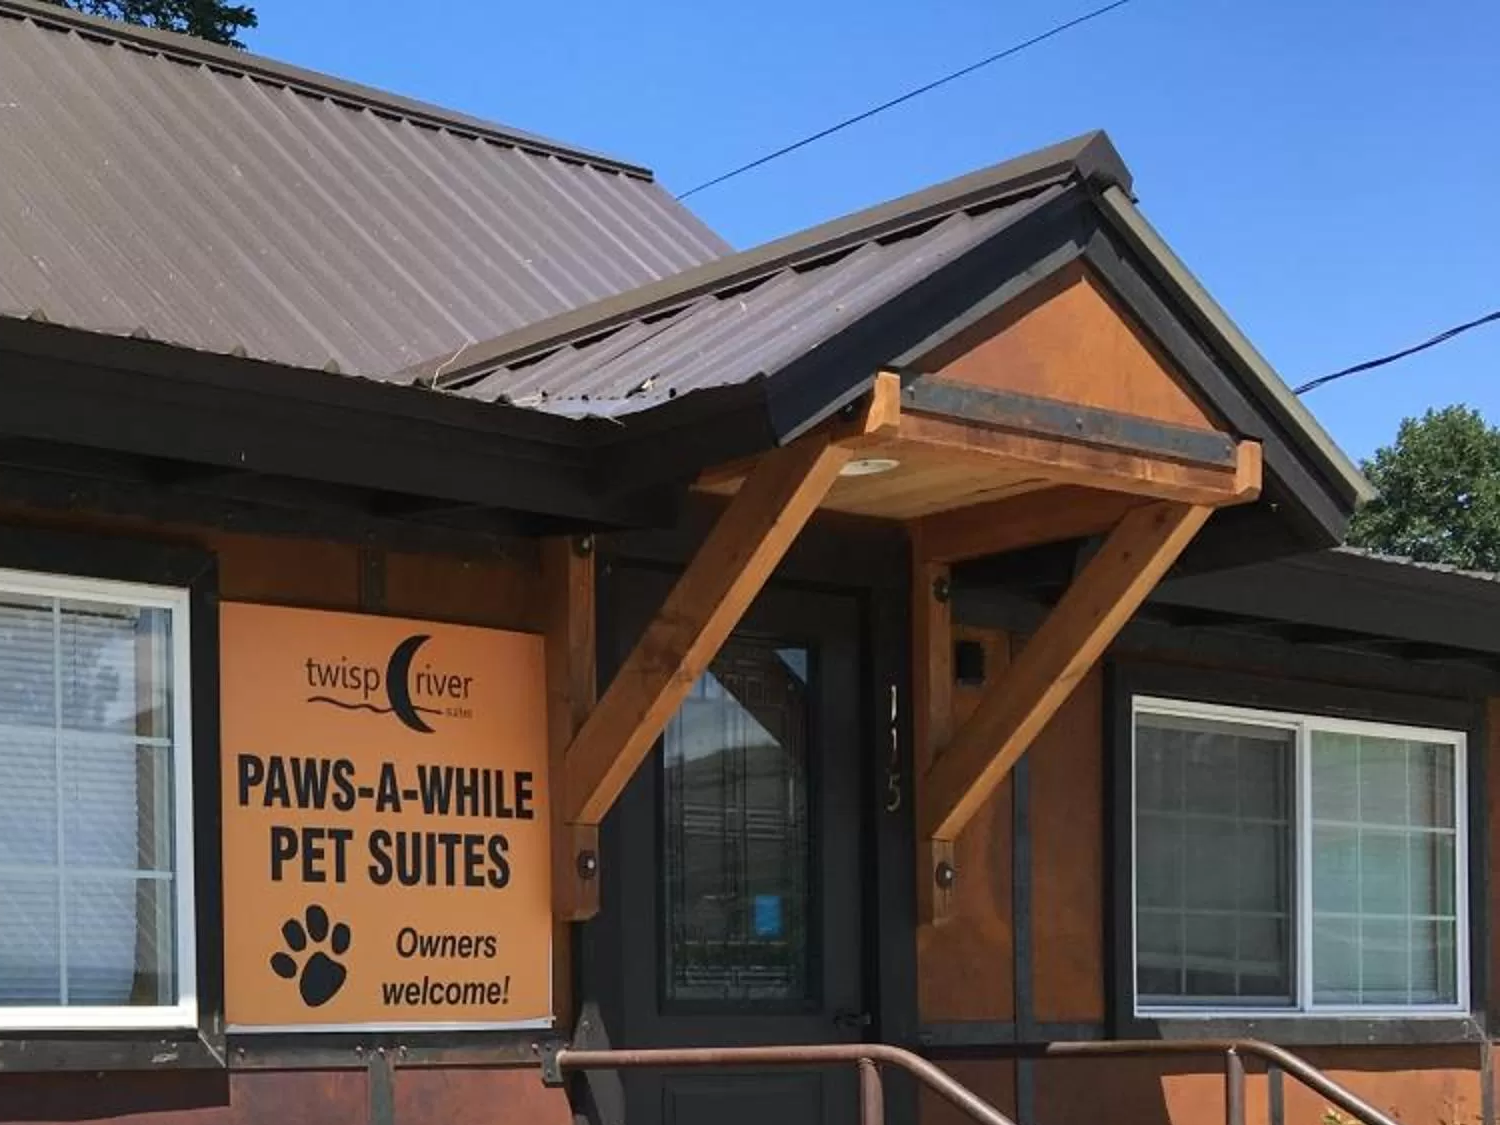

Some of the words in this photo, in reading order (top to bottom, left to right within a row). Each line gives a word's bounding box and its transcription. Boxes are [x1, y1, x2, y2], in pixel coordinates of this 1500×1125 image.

[306, 656, 381, 699] twisp
[416, 664, 473, 698] river
[237, 754, 535, 820] PAWS-A-WHILE
[270, 826, 353, 882] PET
[368, 830, 511, 889] SUITES
[396, 927, 497, 959] Owners
[382, 976, 510, 1006] welcome!
